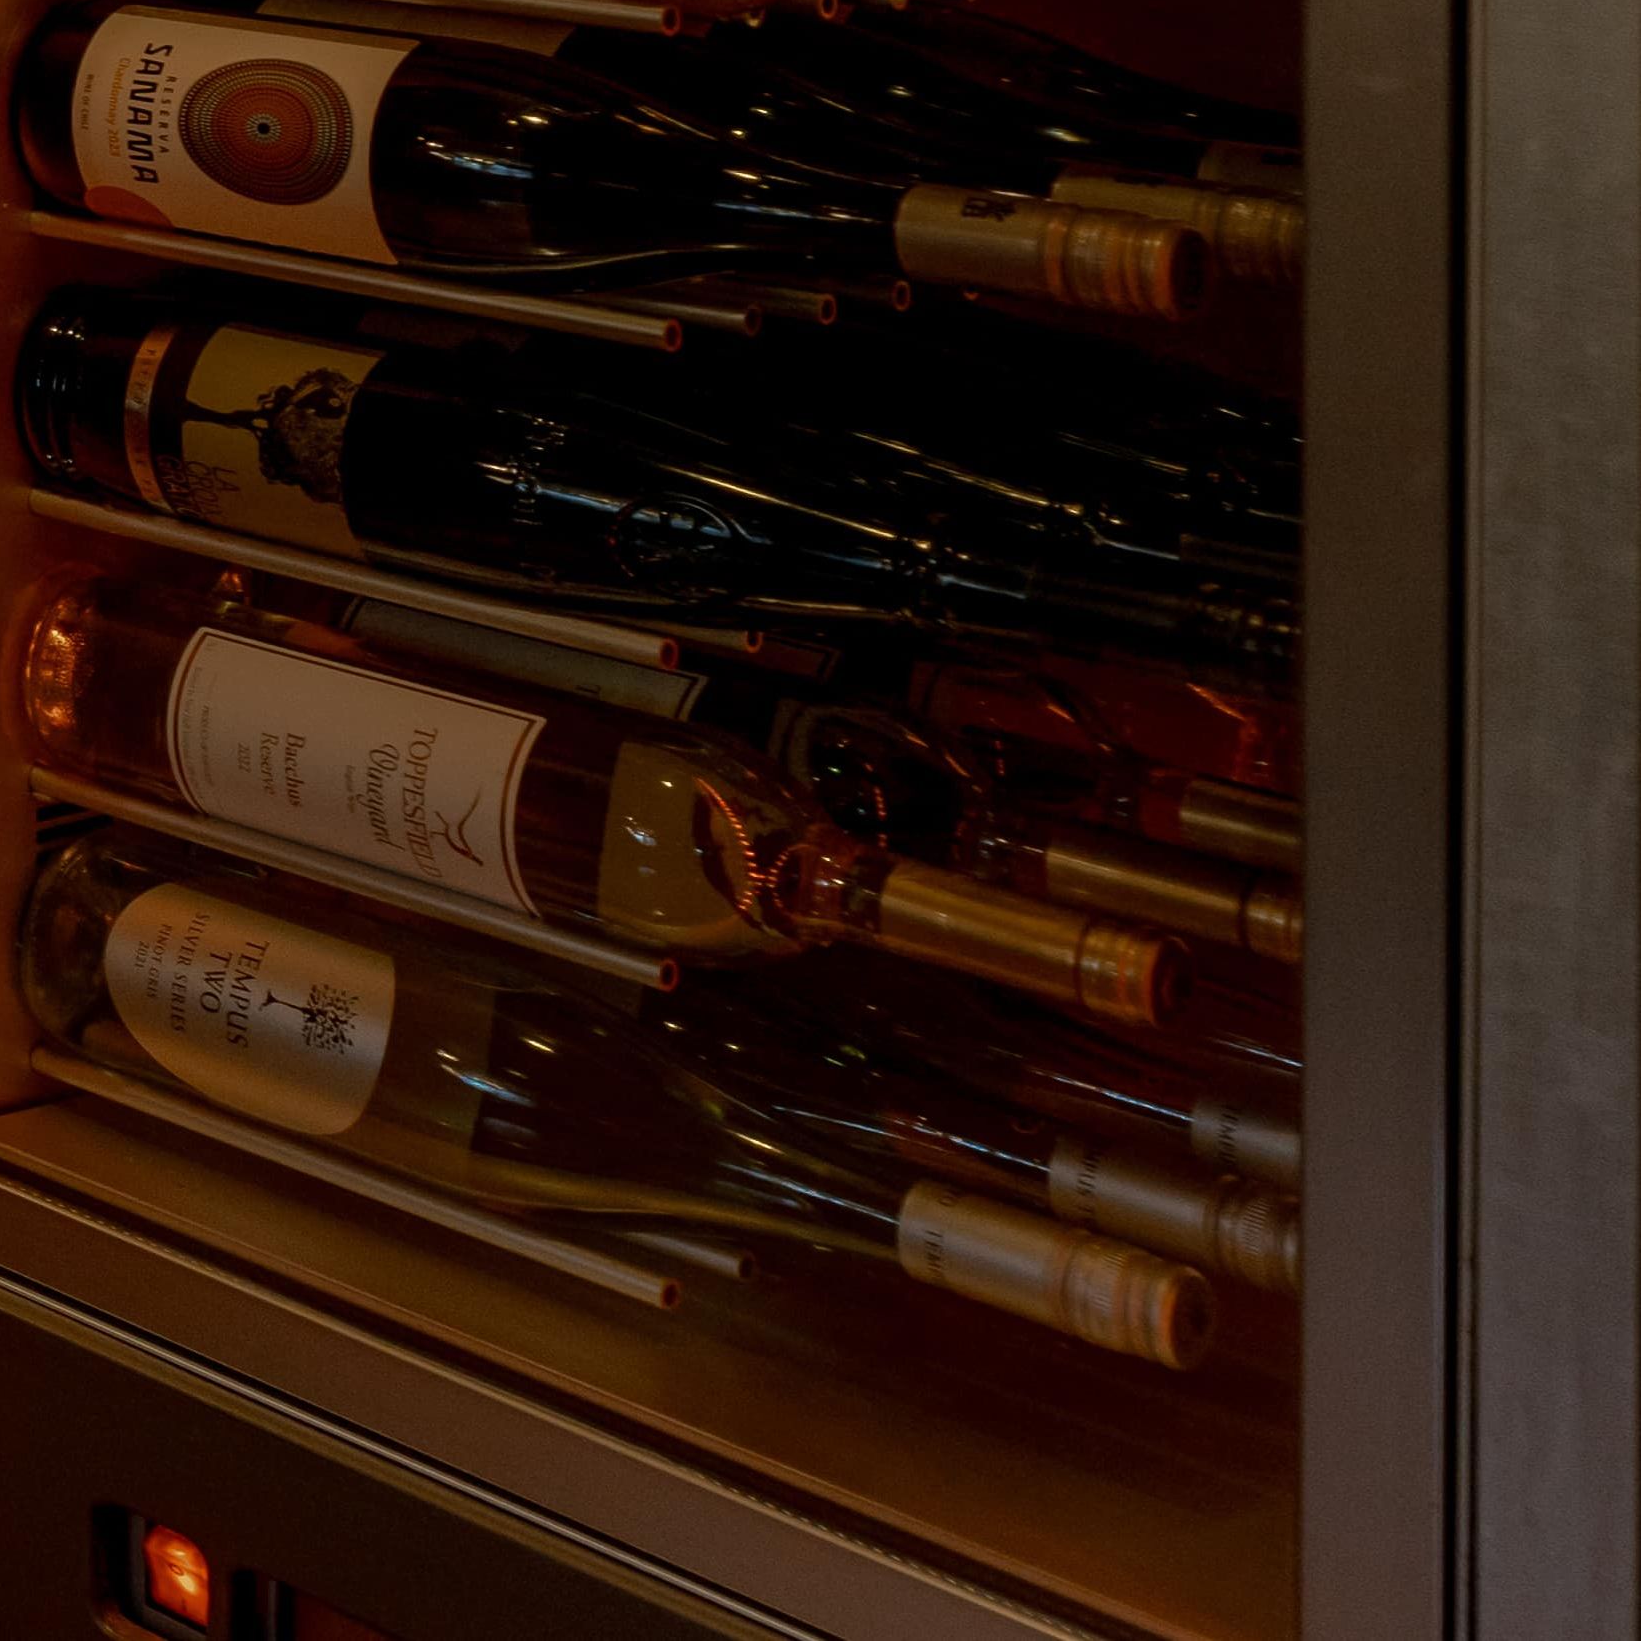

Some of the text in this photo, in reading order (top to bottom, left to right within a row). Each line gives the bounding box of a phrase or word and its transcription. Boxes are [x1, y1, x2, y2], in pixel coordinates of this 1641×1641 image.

[105, 57, 131, 127] Chardonnay
[126, 41, 173, 185] SANAMA
[157, 75, 178, 155] RESERVA
[258, 731, 279, 796] Reserve
[283, 732, 306, 808] Bacchus
[355, 743, 405, 850] Vineyard
[401, 727, 443, 879] TOPPESFIELD
[150, 923, 174, 965] PINOT
[168, 911, 211, 1035] SILVER SERIES
[198, 949, 232, 1014] TWO
[224, 940, 270, 1048] TEMPUS
